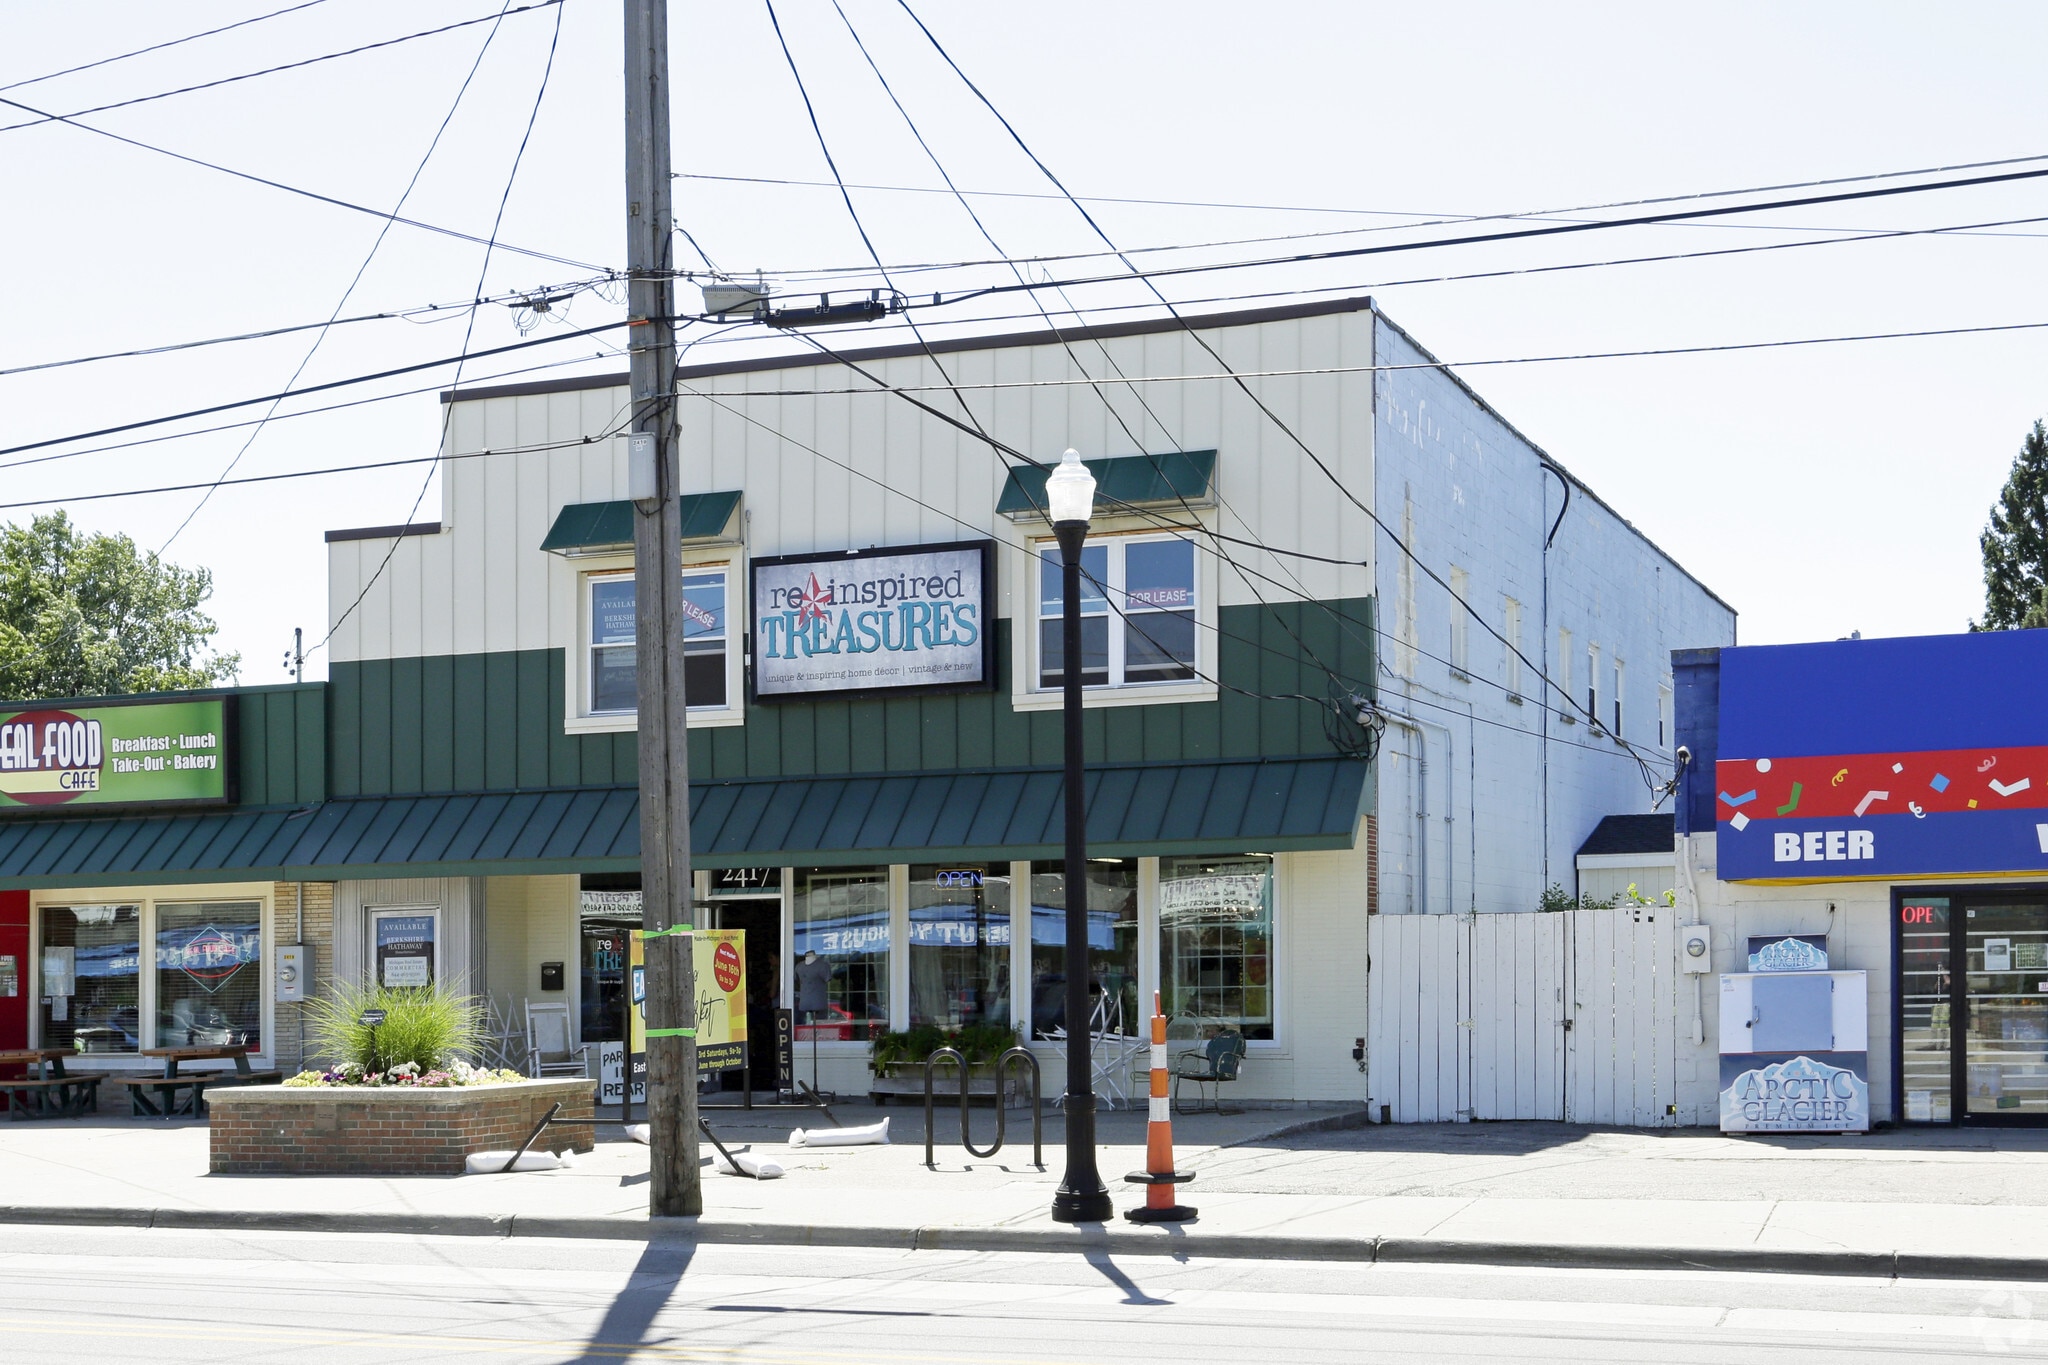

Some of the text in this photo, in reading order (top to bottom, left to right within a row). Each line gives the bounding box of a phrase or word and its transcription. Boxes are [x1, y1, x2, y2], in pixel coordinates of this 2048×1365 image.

[827, 570, 964, 608] inspired
[1130, 590, 1186, 604] FOR LEASE
[601, 601, 636, 609] AVAILAB
[604, 614, 636, 623] BERKSHI
[687, 602, 715, 628] LEASE
[605, 621, 636, 629] HATHAW
[760, 601, 978, 659] TREASURES
[765, 663, 973, 684] unique & inspiring home décor vintage & new
[0, 721, 101, 769] EAL FOOD
[112, 733, 216, 753] Breakfast Lunch
[112, 753, 217, 773] Take-Out Bakery
[60, 771, 96, 789] CAFE
[1774, 830, 1874, 862] BEER
[722, 868, 770, 888] 2417
[937, 871, 983, 888] OPEN
[384, 923, 427, 931] AVAILABLE
[386, 936, 425, 944] BERKSHIRE
[1764, 945, 1810, 959] ARCTIC
[715, 958, 728, 972] June
[1765, 957, 1809, 968] GLACIER
[778, 1018, 790, 1080] OPEN
[698, 1058, 742, 1070] June through October
[1741, 1071, 1853, 1100] ARCTIC
[1743, 1101, 1853, 1122] GLACIER
